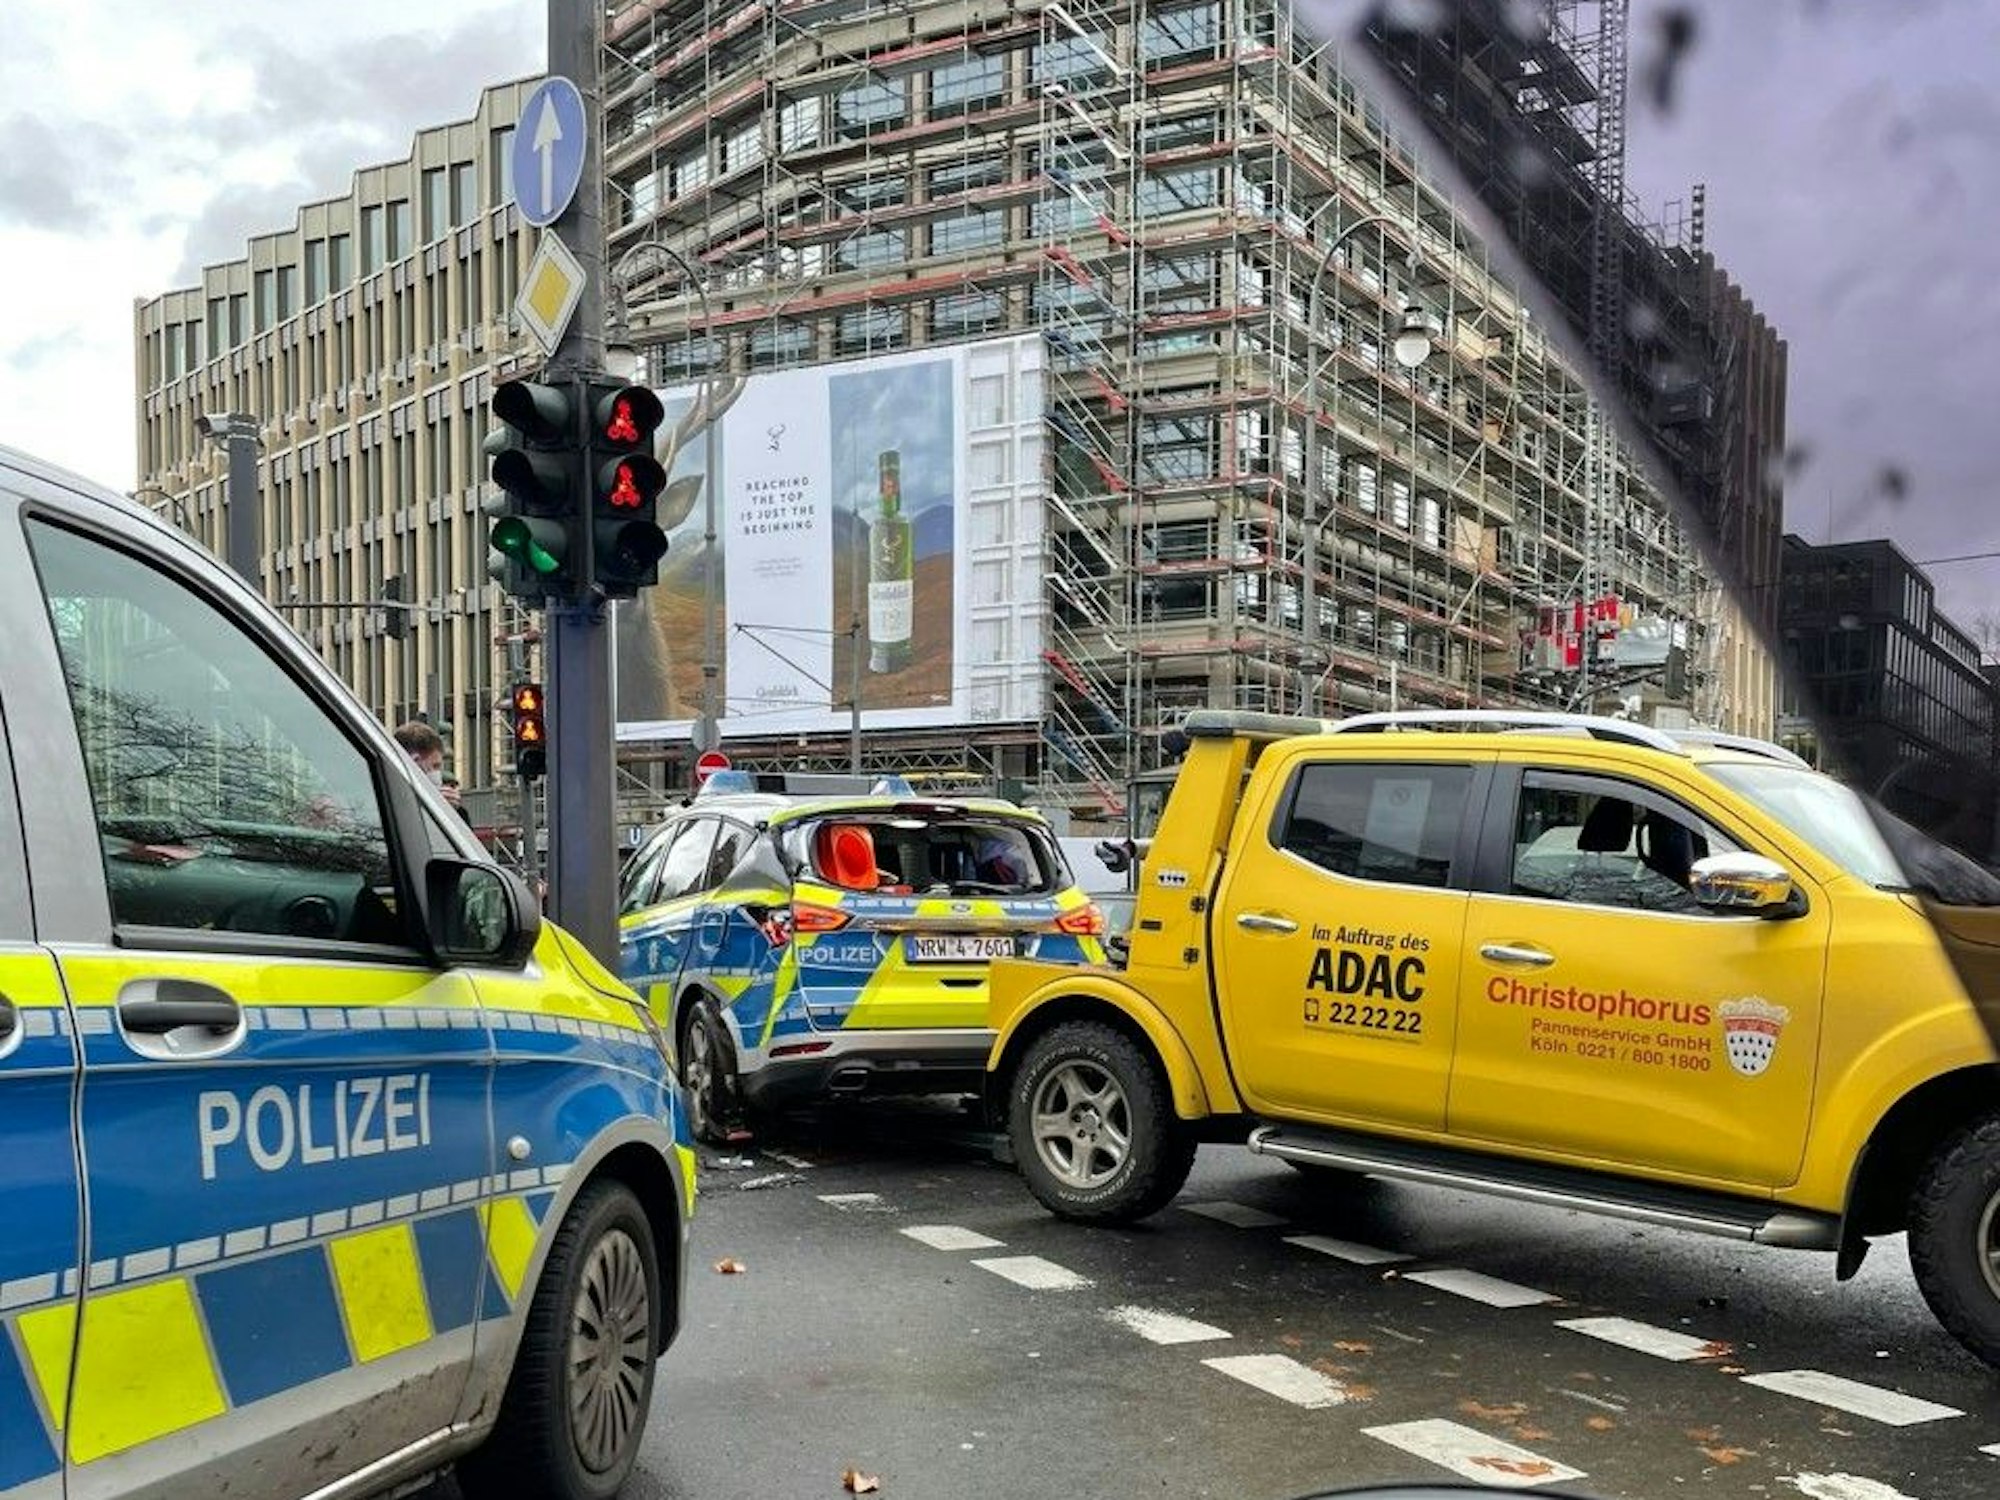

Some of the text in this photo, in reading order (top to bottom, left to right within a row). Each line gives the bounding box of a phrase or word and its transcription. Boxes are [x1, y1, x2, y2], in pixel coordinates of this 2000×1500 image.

[741, 505, 814, 521] IS JUST THE
[752, 491, 803, 505] THE TOP
[915, 939, 947, 957] NRW
[1312, 923, 1429, 951] Im Auftrag des
[800, 946, 877, 964] POLIZEI
[1306, 948, 1425, 1002] ADAC
[1487, 976, 1711, 1026] Christophorus
[1532, 1018, 1711, 1053] Pannenservice GmbH
[1531, 1036, 1567, 1053] Köln
[1577, 1042, 1615, 1059] 0221
[1632, 1049, 1663, 1065] 800
[1670, 1054, 1711, 1072] 1800
[199, 1072, 430, 1180] POLIZEI
